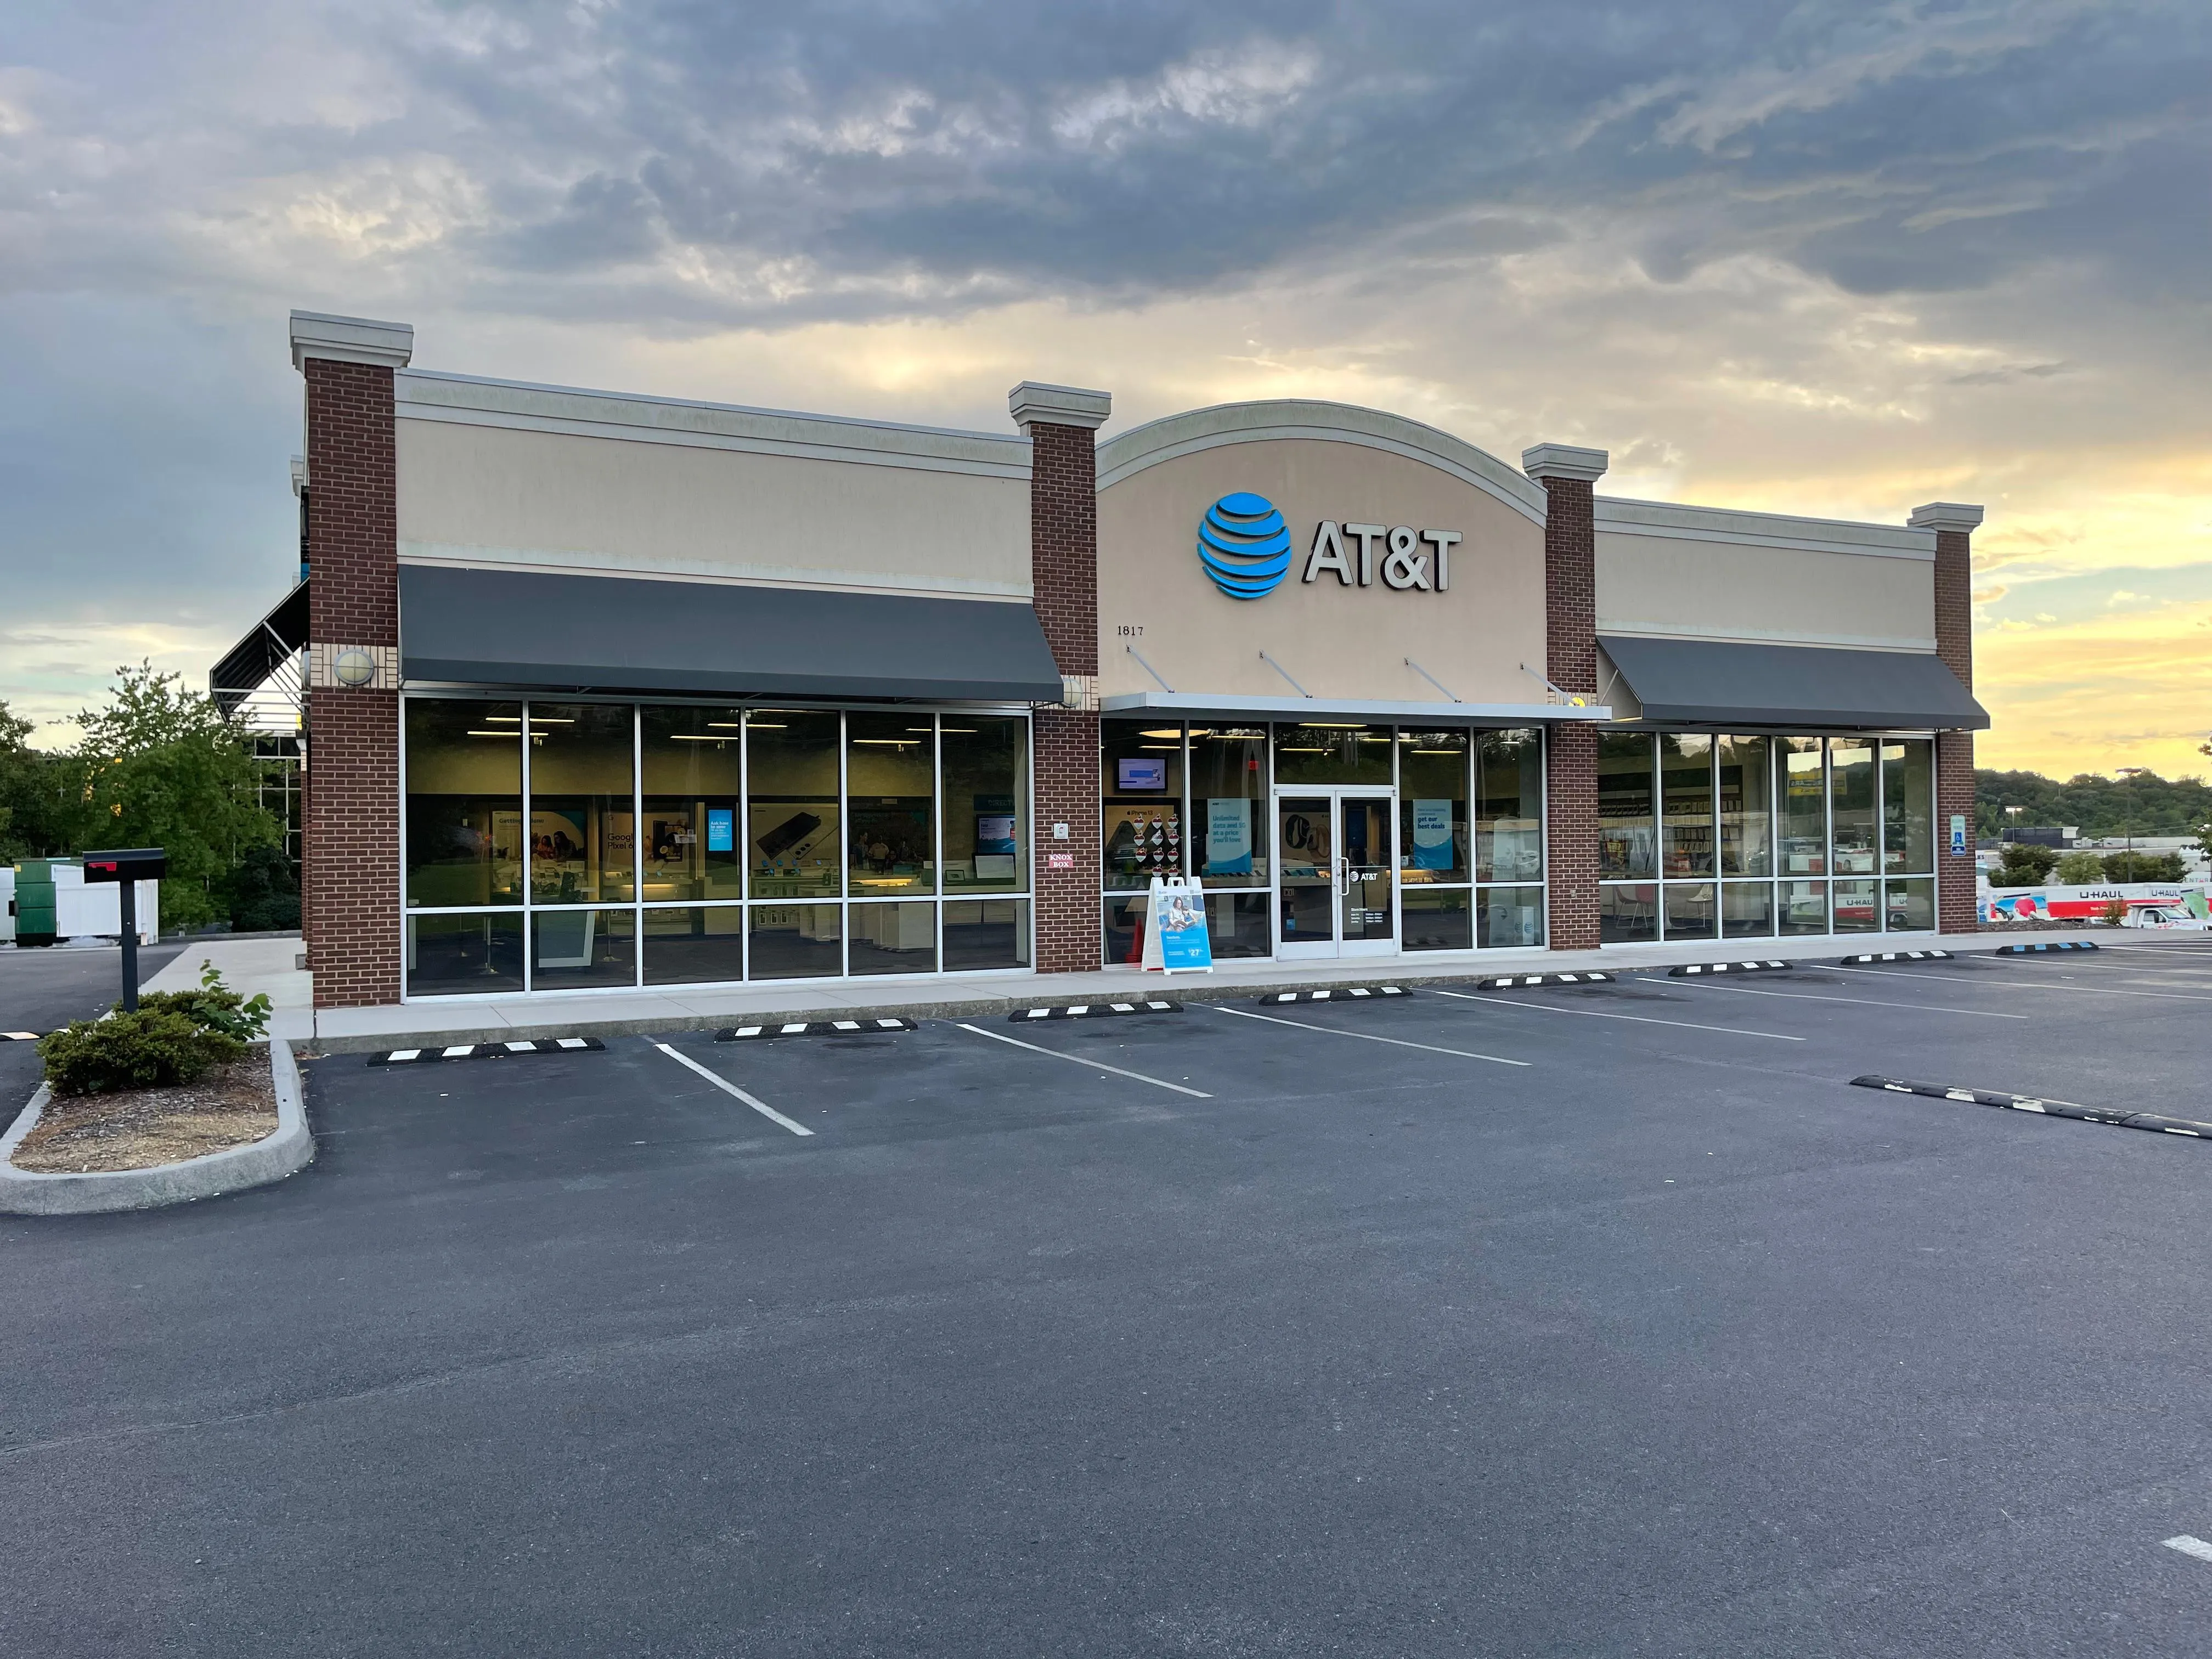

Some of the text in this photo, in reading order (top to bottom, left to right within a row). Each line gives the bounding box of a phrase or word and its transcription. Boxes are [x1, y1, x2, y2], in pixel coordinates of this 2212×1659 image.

[1302, 520, 1463, 592] AT&T
[1118, 625, 1143, 636] 1817
[607, 833, 633, 842] Googl
[2080, 890, 2124, 899] U-HAUL
